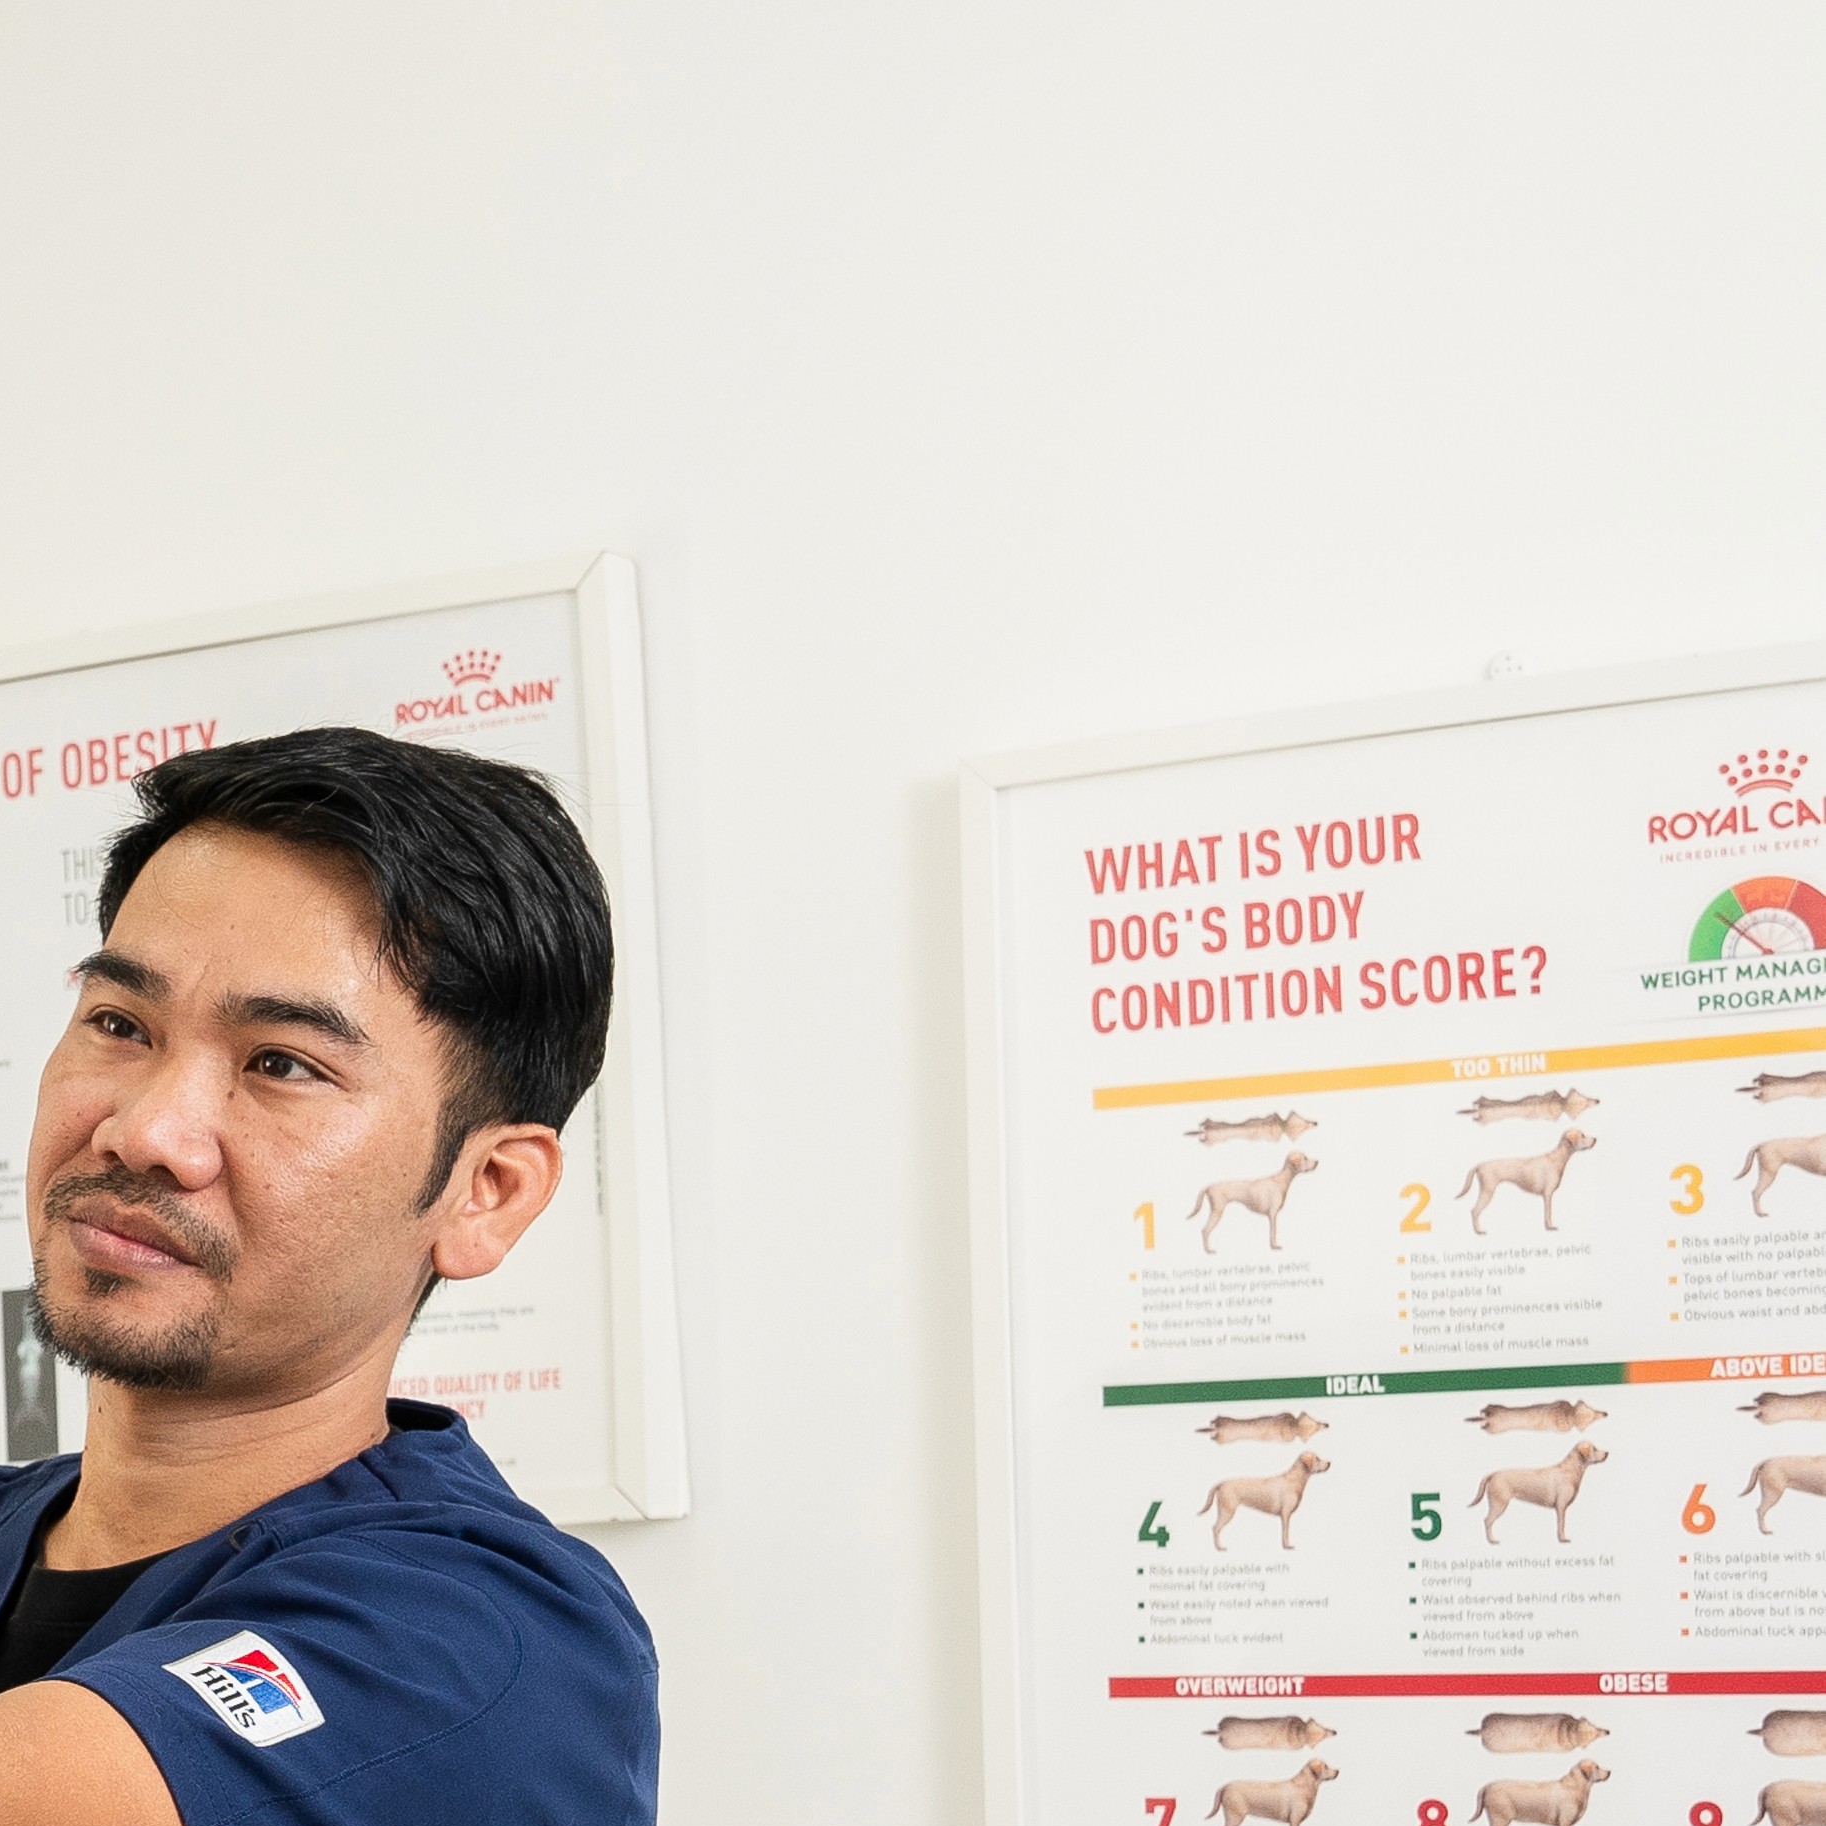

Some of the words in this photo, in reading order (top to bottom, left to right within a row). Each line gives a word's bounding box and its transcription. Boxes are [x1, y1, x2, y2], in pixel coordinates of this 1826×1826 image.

[395, 694, 468, 724] ROYAL
[476, 680, 554, 711] CANIN
[1, 747, 45, 799] OF
[60, 719, 218, 791] OBESITY
[1648, 806, 1759, 844] ROYAL
[1769, 797, 1826, 830] CA
[1085, 834, 1222, 895] WHAT
[1240, 828, 1282, 880] IS
[1296, 812, 1421, 873] YOUR
[1660, 846, 1747, 864] INCREDIBLE
[1753, 843, 1768, 853] IN
[1775, 838, 1819, 852] EVERY
[62, 846, 99, 882] THI
[1090, 905, 1228, 964] DOG'S
[1244, 890, 1364, 950] BODY
[1641, 966, 1728, 990] WEIGHT
[1736, 956, 1826, 982] MANAG
[1091, 965, 1343, 1035] CONDITION
[1360, 945, 1547, 1011] SCORE?
[1451, 1058, 1494, 1079] TOO
[1499, 1053, 1546, 1075] THIN
[1669, 1163, 1705, 1215] 3
[1399, 1185, 1432, 1233] 2
[1134, 1204, 1155, 1250] 1
[1681, 1234, 1710, 1248] Ribs
[1714, 1232, 1751, 1249] easily
[1753, 1228, 1810, 1247] palpable
[1682, 1250, 1723, 1265] visible
[1726, 1248, 1754, 1262] with
[1757, 1250, 1773, 1260] no
[1410, 1267, 1447, 1281] bones
[1450, 1265, 1484, 1282] easily
[1487, 1263, 1526, 1277] visible
[1684, 1271, 1713, 1288] Tops
[1716, 1270, 1729, 1283] of
[1732, 1267, 1779, 1282] lumbar
[1411, 1286, 1428, 1299] No
[1431, 1284, 1483, 1301] palpable
[1486, 1283, 1502, 1296] fat
[1683, 1287, 1719, 1304] pelvic
[1723, 1285, 1763, 1299] bones
[1412, 1304, 1446, 1318] Some
[1449, 1303, 1478, 1319] bony
[1481, 1299, 1560, 1317] prominences
[1564, 1297, 1603, 1310] visible
[1684, 1306, 1735, 1321] Obvious
[1738, 1304, 1772, 1318] waist
[1776, 1303, 1800, 1316] and
[1413, 1340, 1462, 1354] Minimal
[1465, 1338, 1490, 1351] loss
[1493, 1338, 1504, 1350] of
[1508, 1335, 1553, 1349] muscle
[1556, 1336, 1590, 1347] mass
[1710, 1356, 1783, 1378] ABOVE
[434, 1372, 498, 1396] QUALITY
[504, 1370, 522, 1391] OF
[529, 1367, 561, 1390] LIFE
[1326, 1376, 1385, 1394] IDEAL
[1410, 1492, 1443, 1543] 5
[1681, 1483, 1716, 1535] 6
[1137, 1501, 1170, 1548] 4
[1693, 1551, 1721, 1563] Ribs
[1725, 1549, 1780, 1565] palpable
[1783, 1549, 1811, 1561] with
[1693, 1569, 1710, 1581] fat
[1714, 1568, 1770, 1584] covering
[1694, 1587, 1729, 1600] Waist
[1732, 1587, 1743, 1599] is
[1747, 1586, 1819, 1599] discernible
[1694, 1605, 1725, 1617] from
[1728, 1604, 1766, 1617] above
[1769, 1604, 1791, 1616] but
[1794, 1603, 1806, 1615] is
[1695, 1624, 1764, 1637] Abdominal
[1767, 1624, 1795, 1636] tuck
[1175, 1675, 1305, 1696] OVERWEIGHT
[1598, 1673, 1669, 1694] OBESE
[190, 1666, 256, 1729] Hill's
